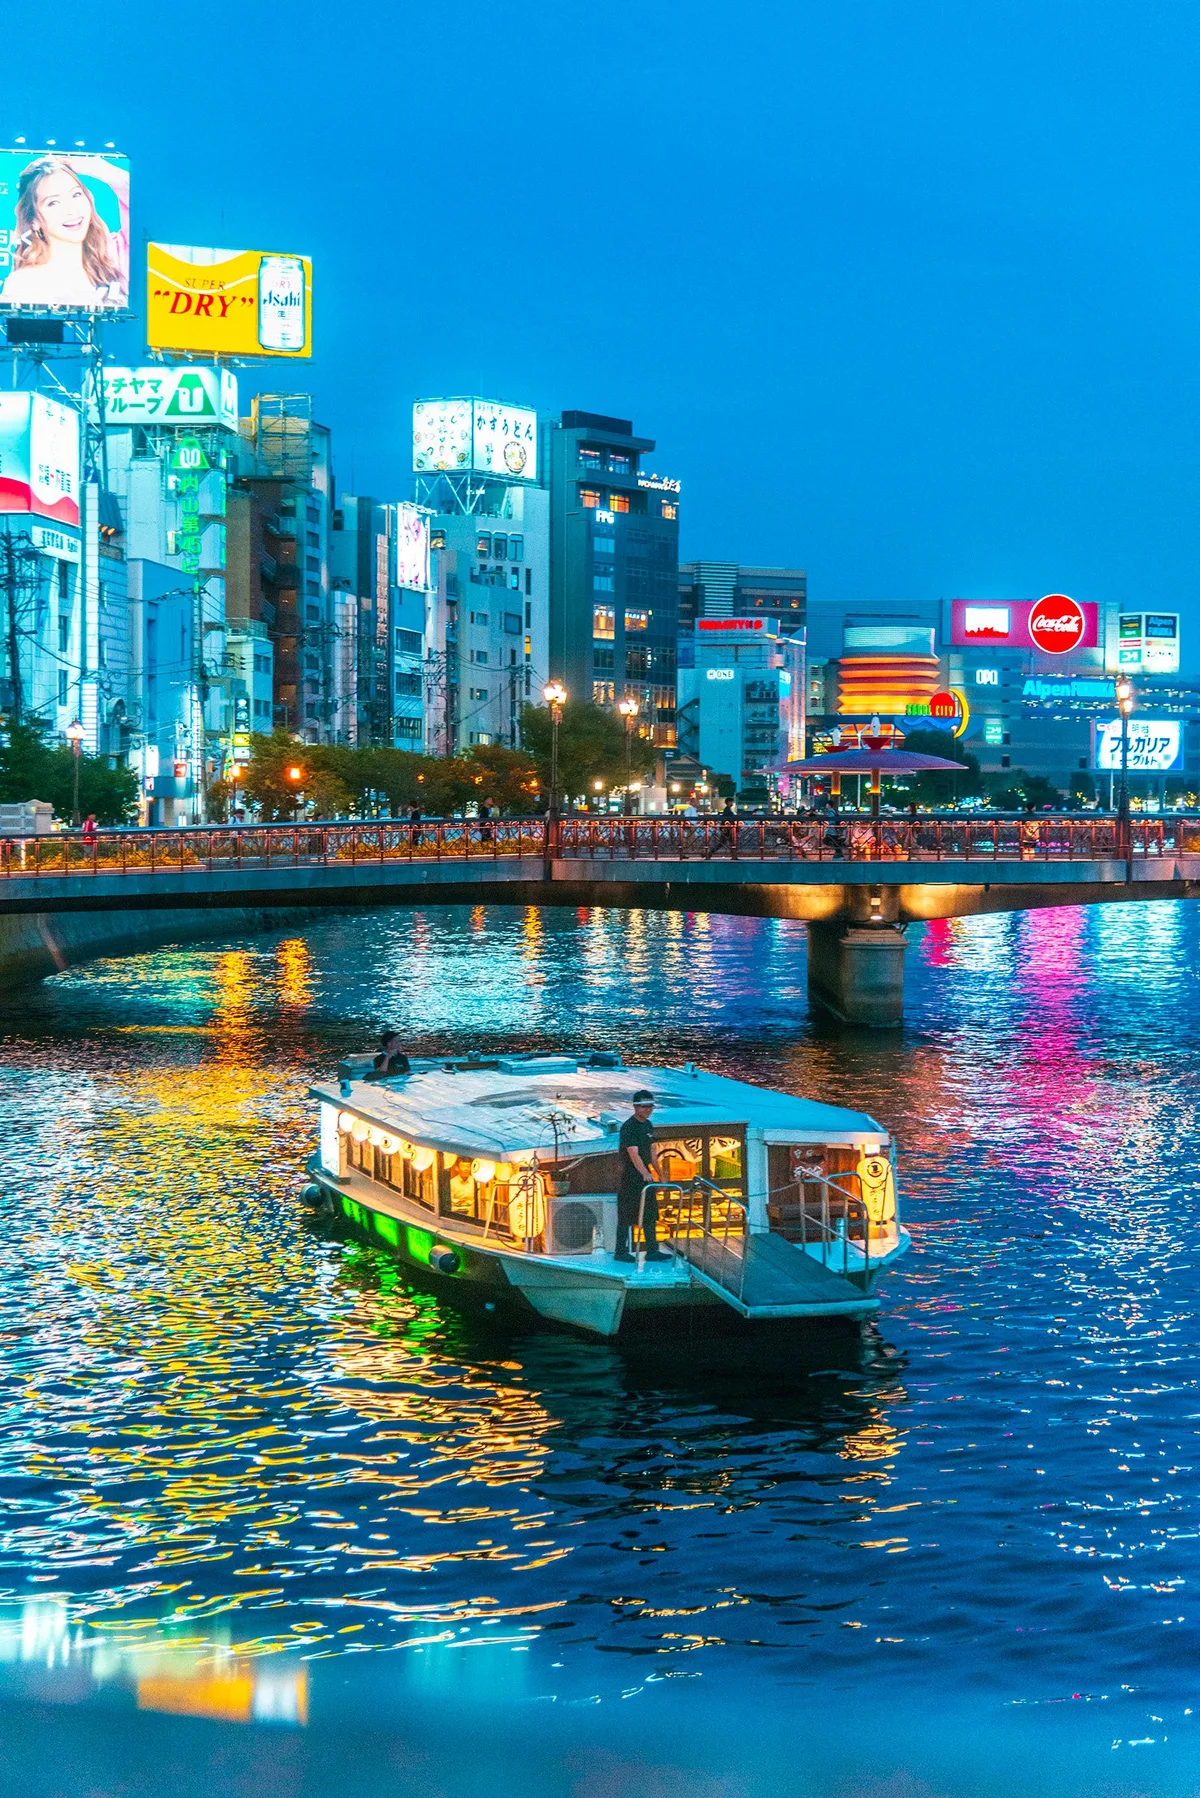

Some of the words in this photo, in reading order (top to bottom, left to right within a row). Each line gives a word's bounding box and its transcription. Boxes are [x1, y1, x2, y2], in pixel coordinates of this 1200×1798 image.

[184, 278, 226, 290] SUPER
[263, 290, 300, 307] Asahi
[477, 415, 533, 441] かすうどん
[595, 510, 615, 524] FPG
[180, 475, 201, 594] 内山第45ビ
[1032, 614, 1082, 633] Coca-Cola
[935, 705, 953, 716] CITY
